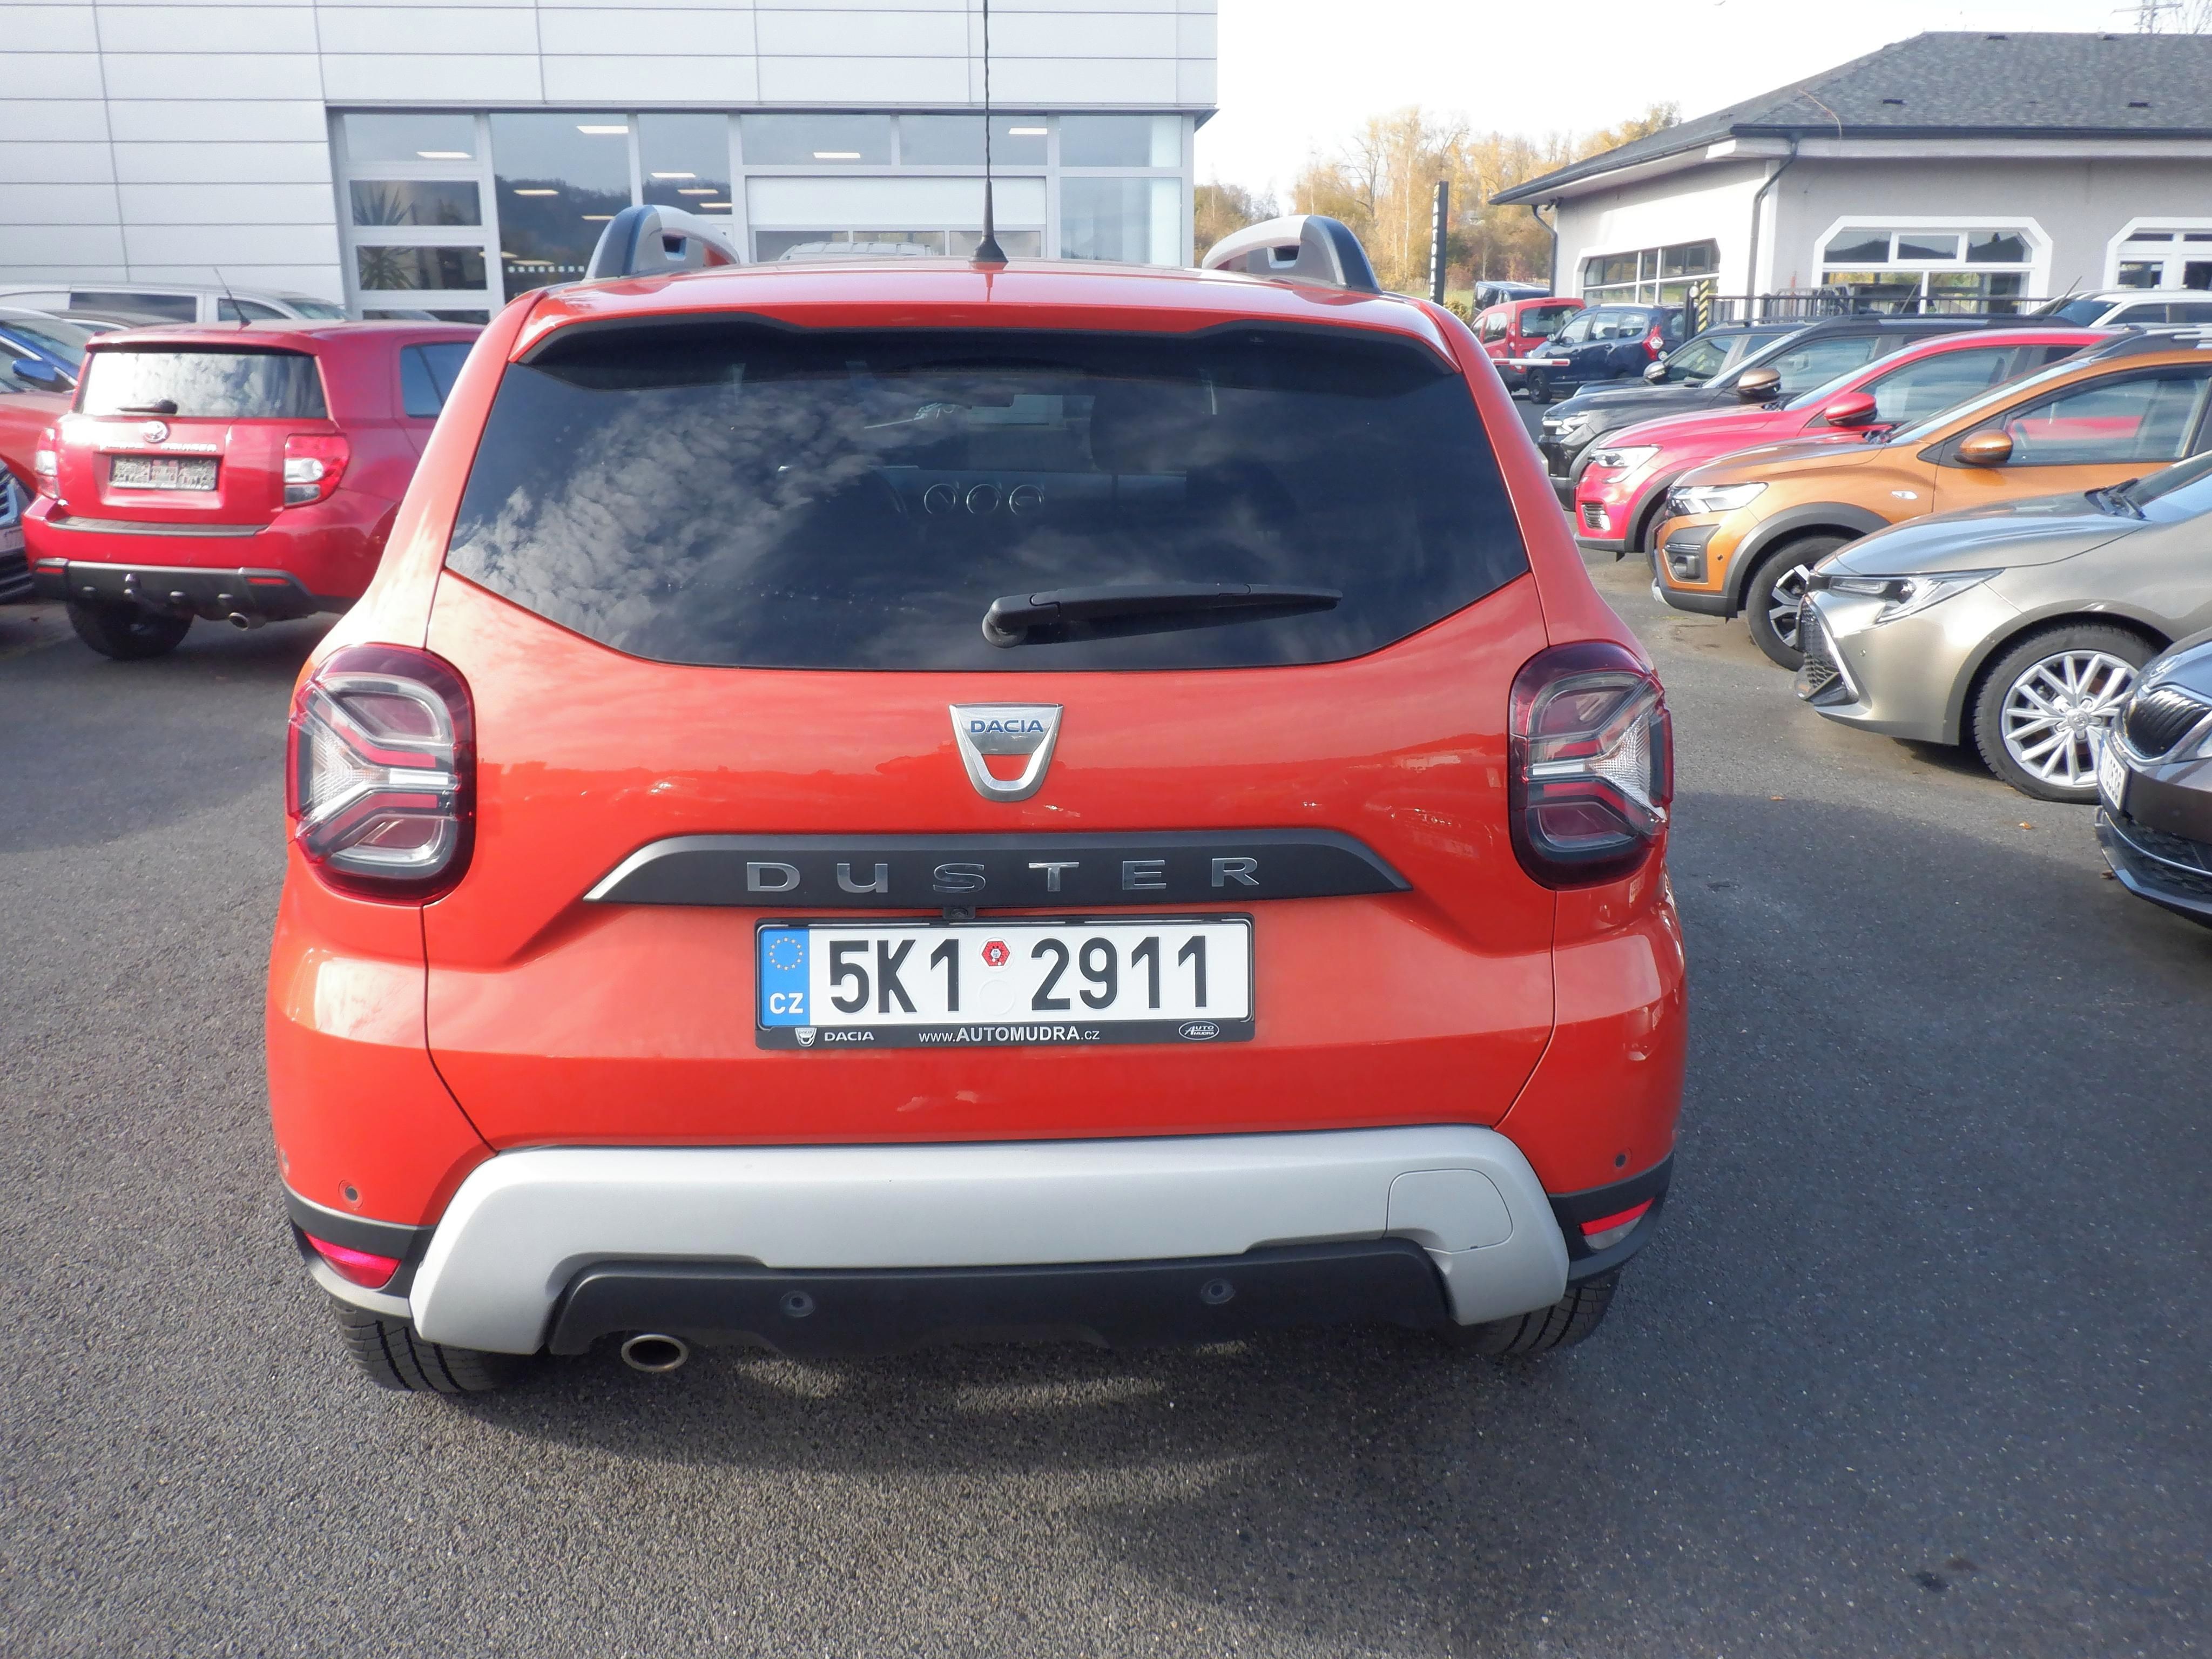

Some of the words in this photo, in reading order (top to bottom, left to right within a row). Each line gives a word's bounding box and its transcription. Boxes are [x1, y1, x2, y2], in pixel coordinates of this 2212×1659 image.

[970, 720, 1043, 733] DACIA
[746, 857, 1260, 894] DUSTER
[829, 938, 960, 1013] 5K1
[1030, 935, 1208, 1011] 2911
[770, 992, 803, 1014] CZ
[824, 1031, 874, 1041] DACIA
[919, 1026, 1100, 1042] www.AUTOMUDRA.cz
